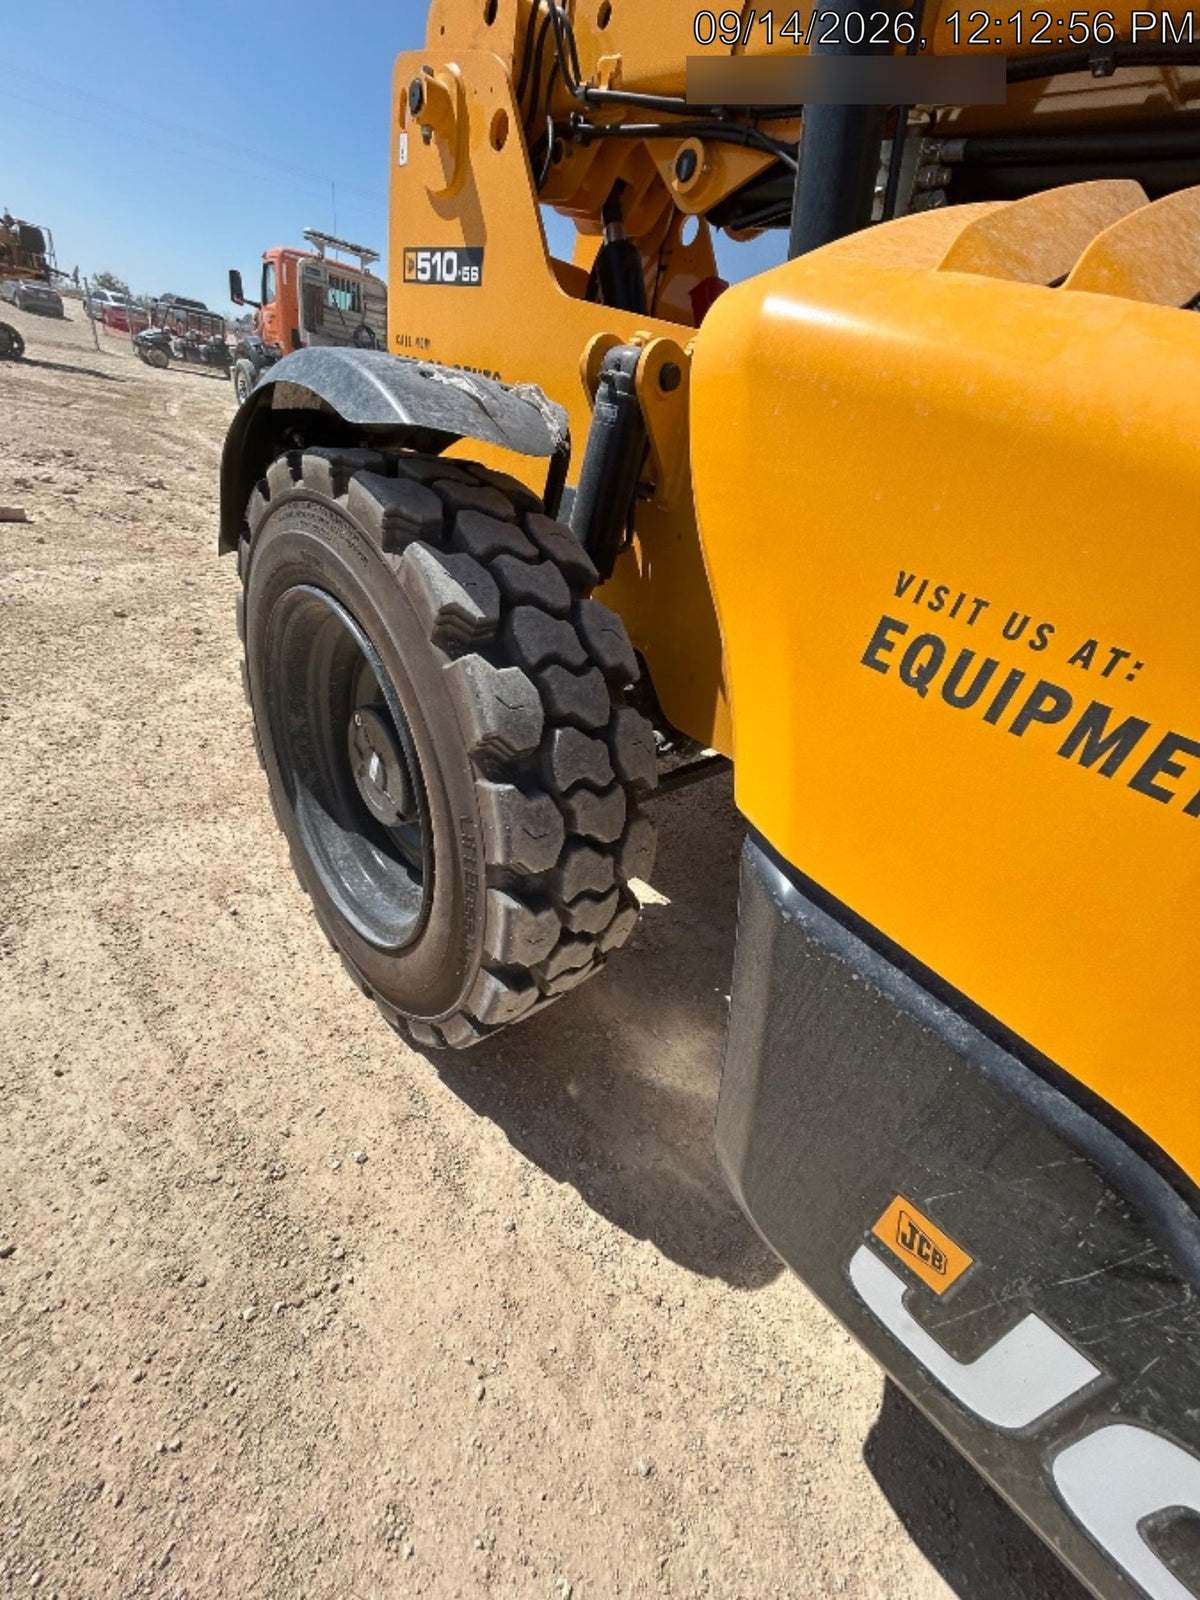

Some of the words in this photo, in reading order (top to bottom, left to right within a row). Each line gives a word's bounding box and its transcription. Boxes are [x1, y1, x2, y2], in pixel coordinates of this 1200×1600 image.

[894, 570, 990, 626] VISIT
[1002, 611, 1055, 652] US
[1067, 639, 1144, 682] AT:
[860, 615, 1200, 818] EQUIPME
[901, 1220, 943, 1271] JCB
